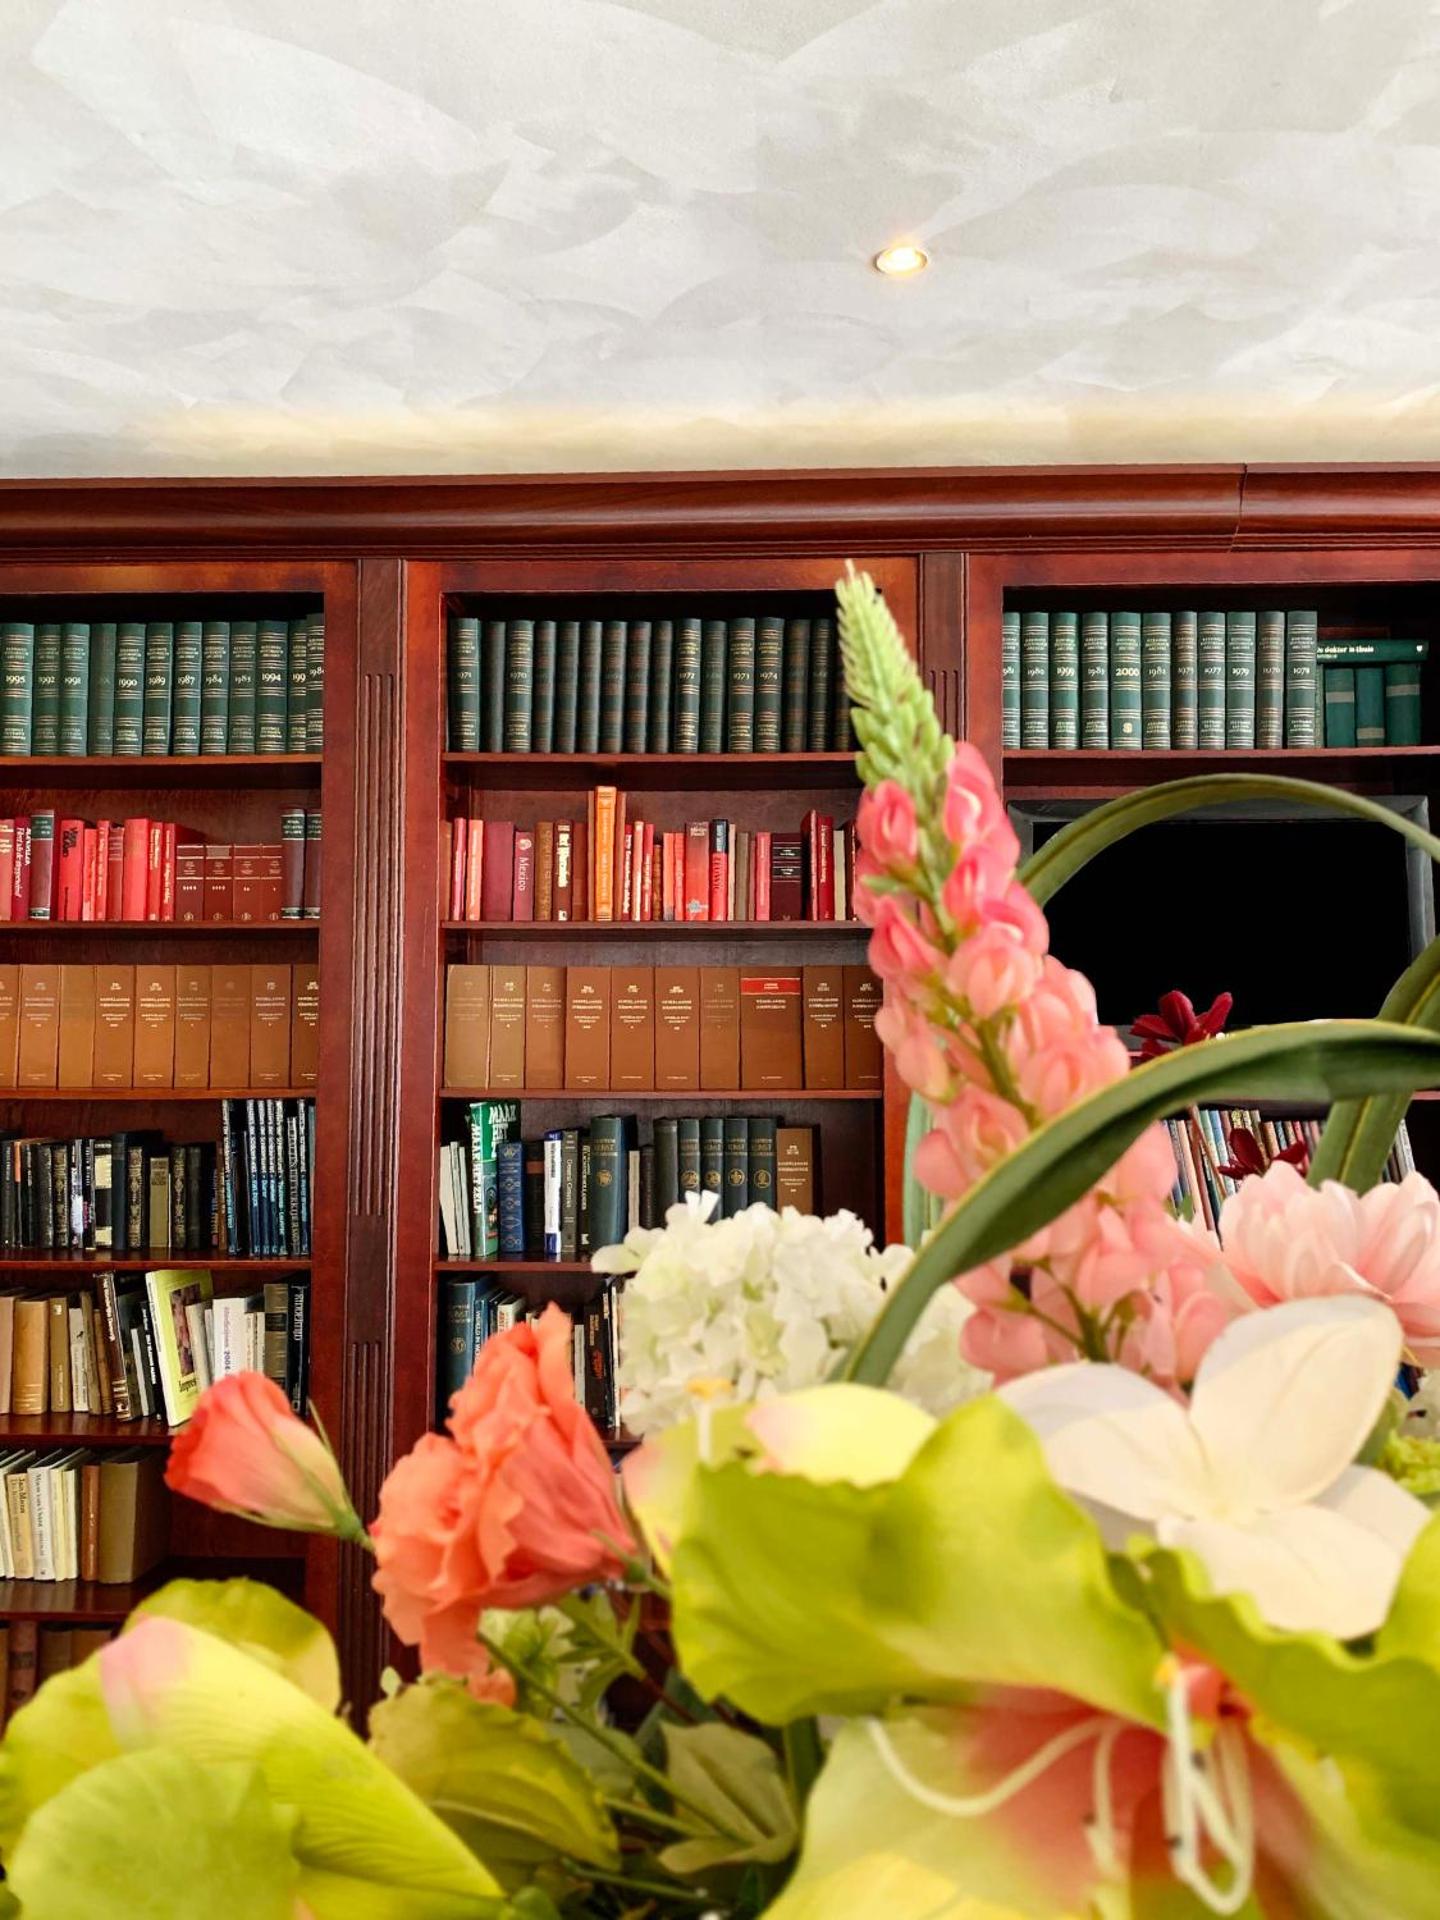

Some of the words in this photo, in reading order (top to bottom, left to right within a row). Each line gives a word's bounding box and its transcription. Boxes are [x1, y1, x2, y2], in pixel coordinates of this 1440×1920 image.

[292, 672, 307, 683] 199
[1115, 667, 1140, 677] 2000
[517, 856, 530, 892] Mexico
[488, 1104, 517, 1125] MAAK
[470, 1123, 483, 1161] MAAK
[471, 1163, 483, 1185] HET
